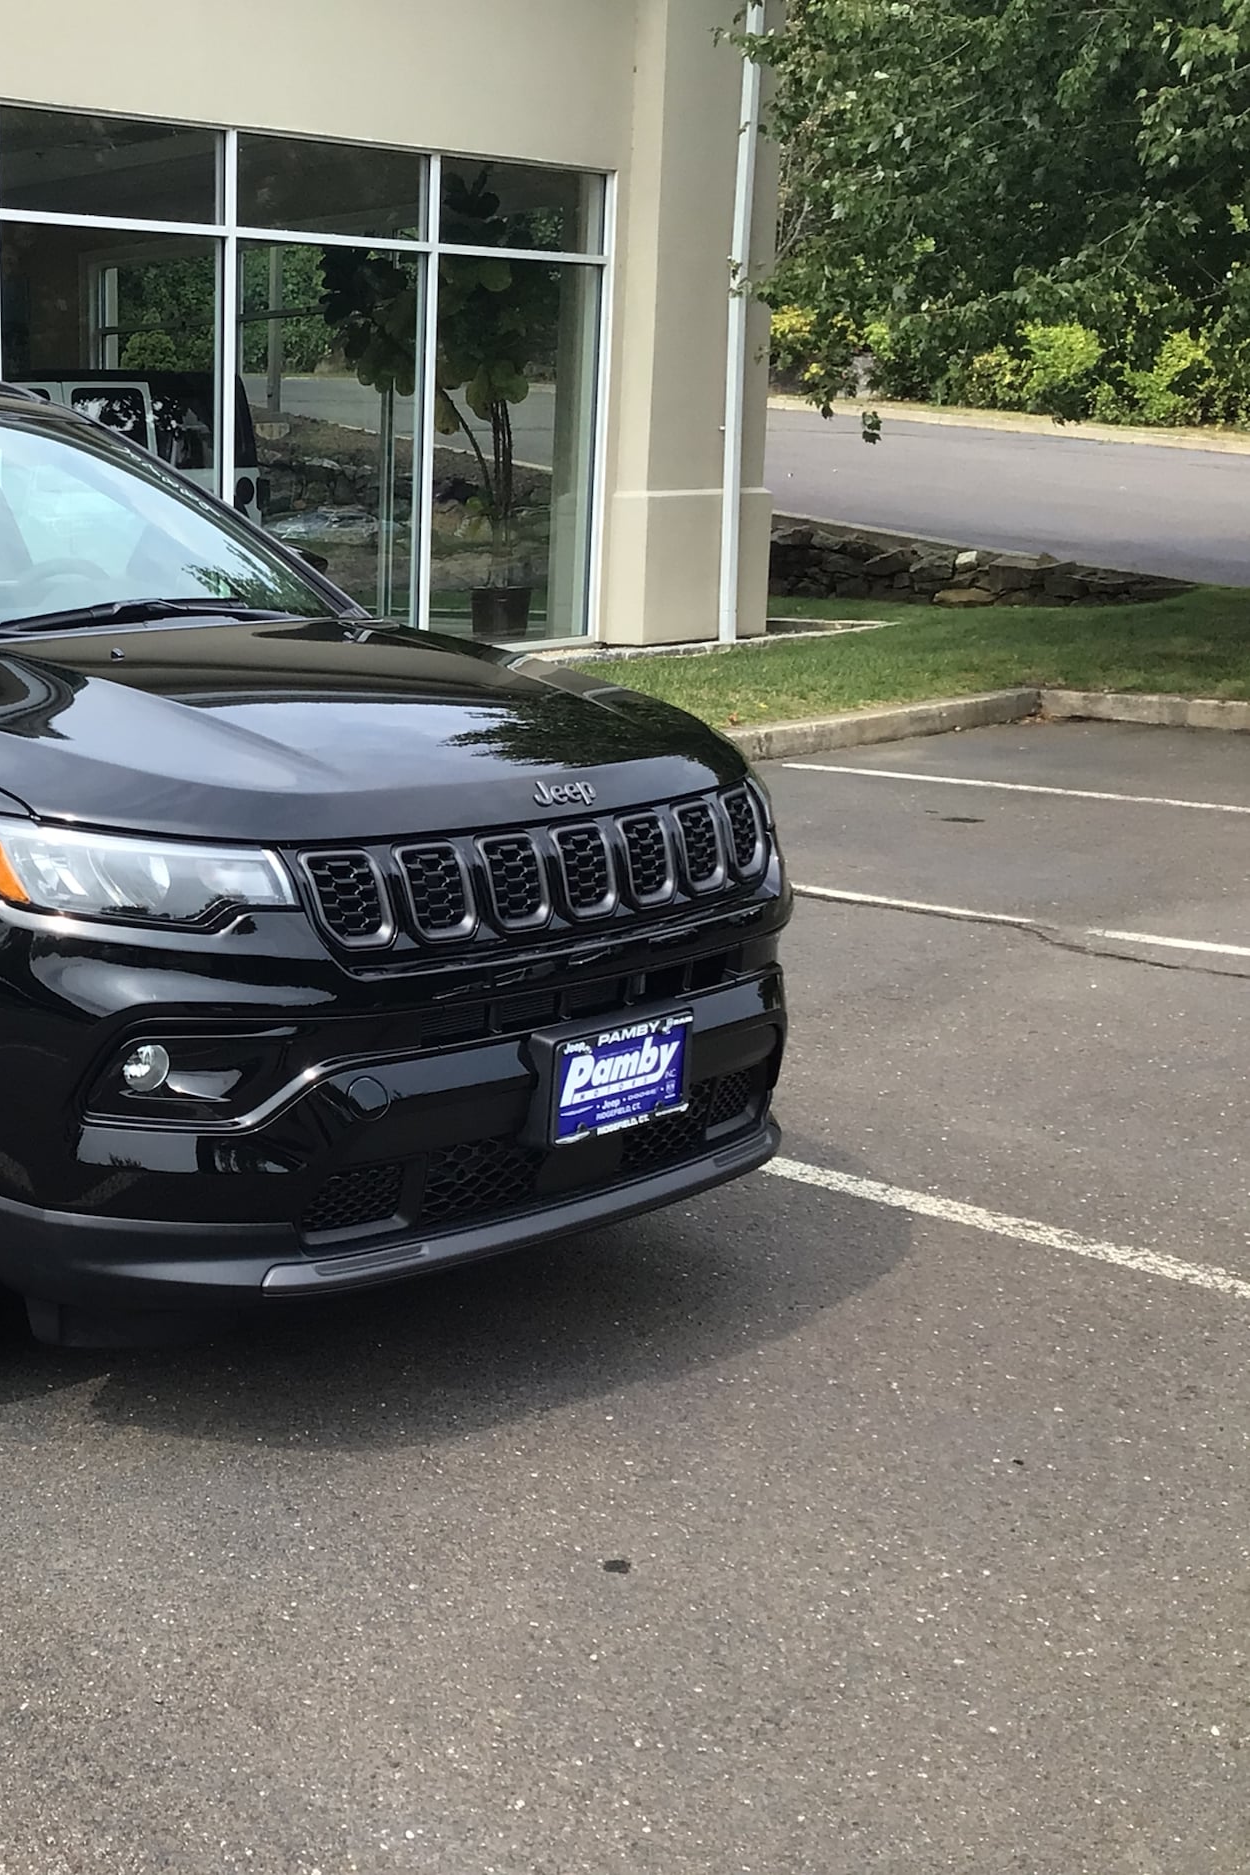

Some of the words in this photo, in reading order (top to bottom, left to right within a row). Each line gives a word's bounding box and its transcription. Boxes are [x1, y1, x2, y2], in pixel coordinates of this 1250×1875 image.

[533, 781, 596, 807] Jeep
[597, 1020, 660, 1046] PAMBY
[560, 1036, 681, 1107] Pamby
[601, 1098, 620, 1110] Jeep
